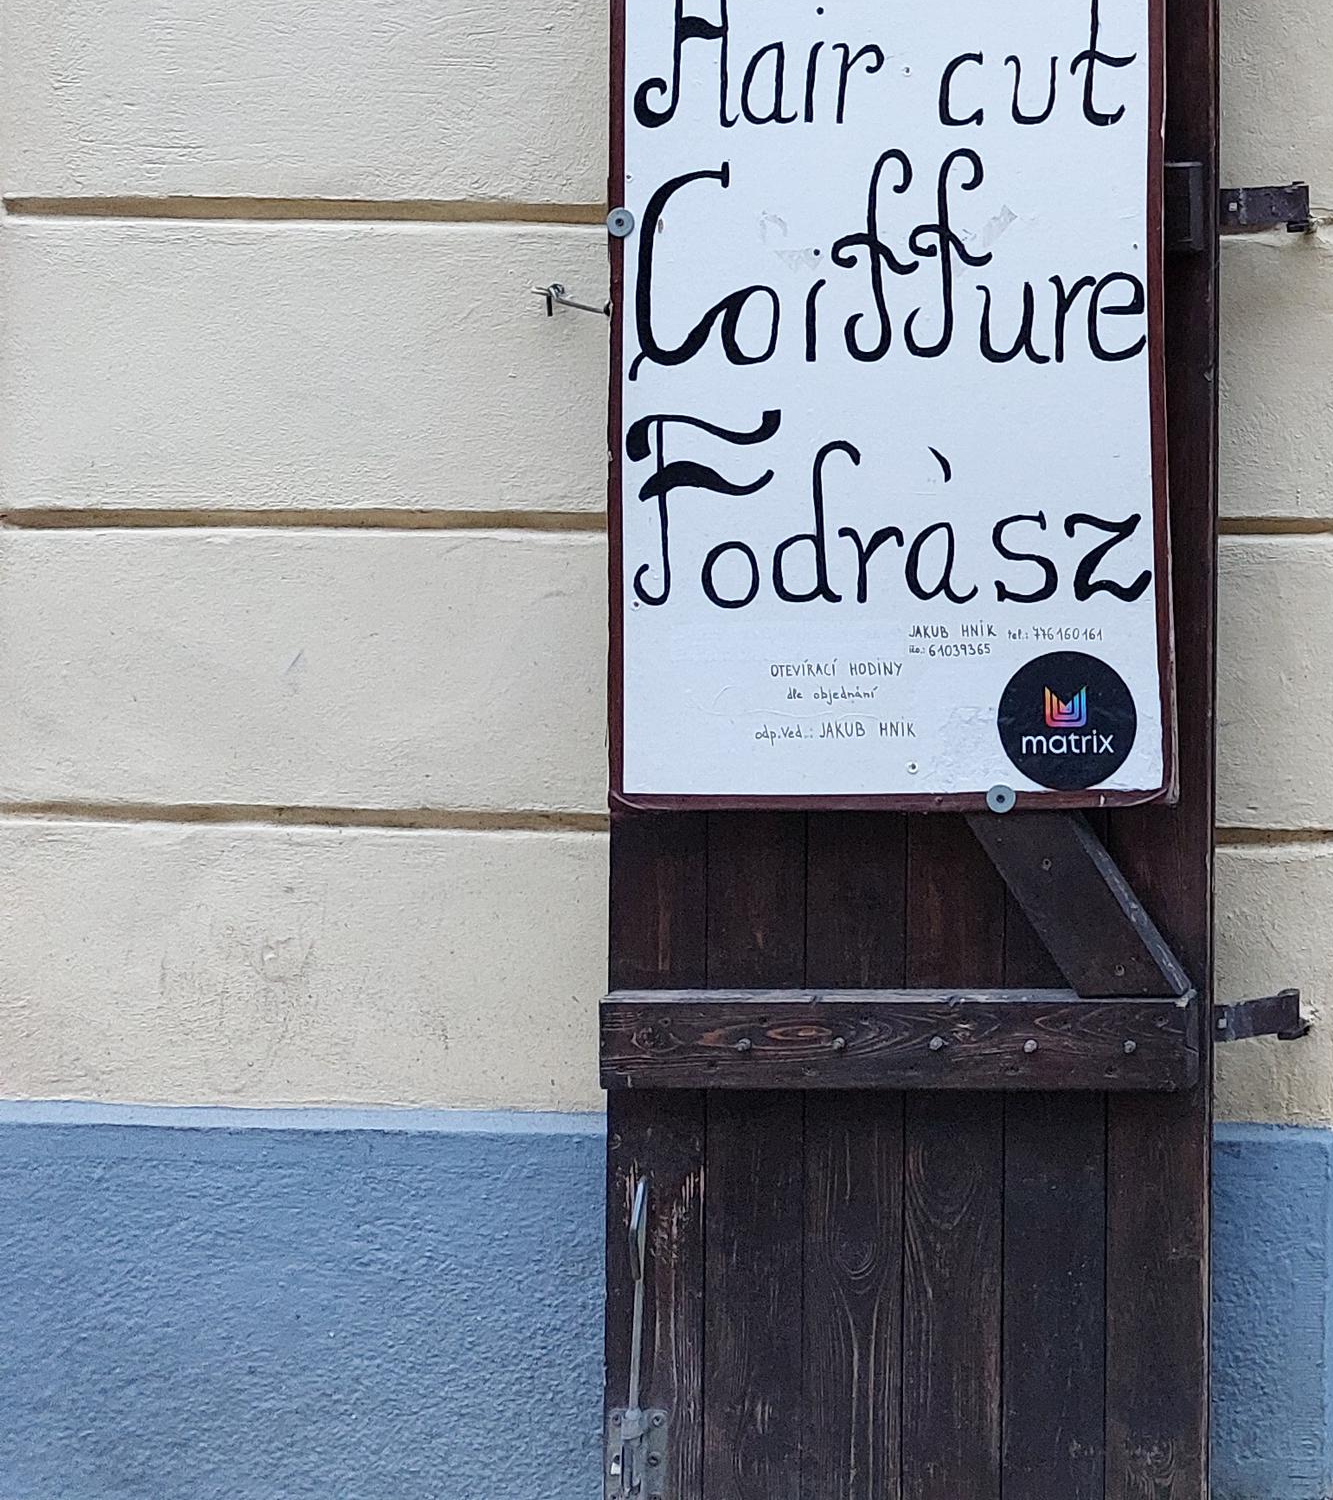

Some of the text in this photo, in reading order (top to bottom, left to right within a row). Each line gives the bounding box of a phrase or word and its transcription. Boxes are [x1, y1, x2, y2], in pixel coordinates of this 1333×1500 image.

[626, 148, 1146, 381] Coiffure
[908, 625, 949, 639] JAKUB
[1032, 626, 1103, 641] 776160161
[928, 643, 991, 657] 61039365
[770, 658, 838, 677] OTEVÍRACÍ
[819, 721, 866, 739] JAKUB
[1020, 730, 1115, 755] matrix
